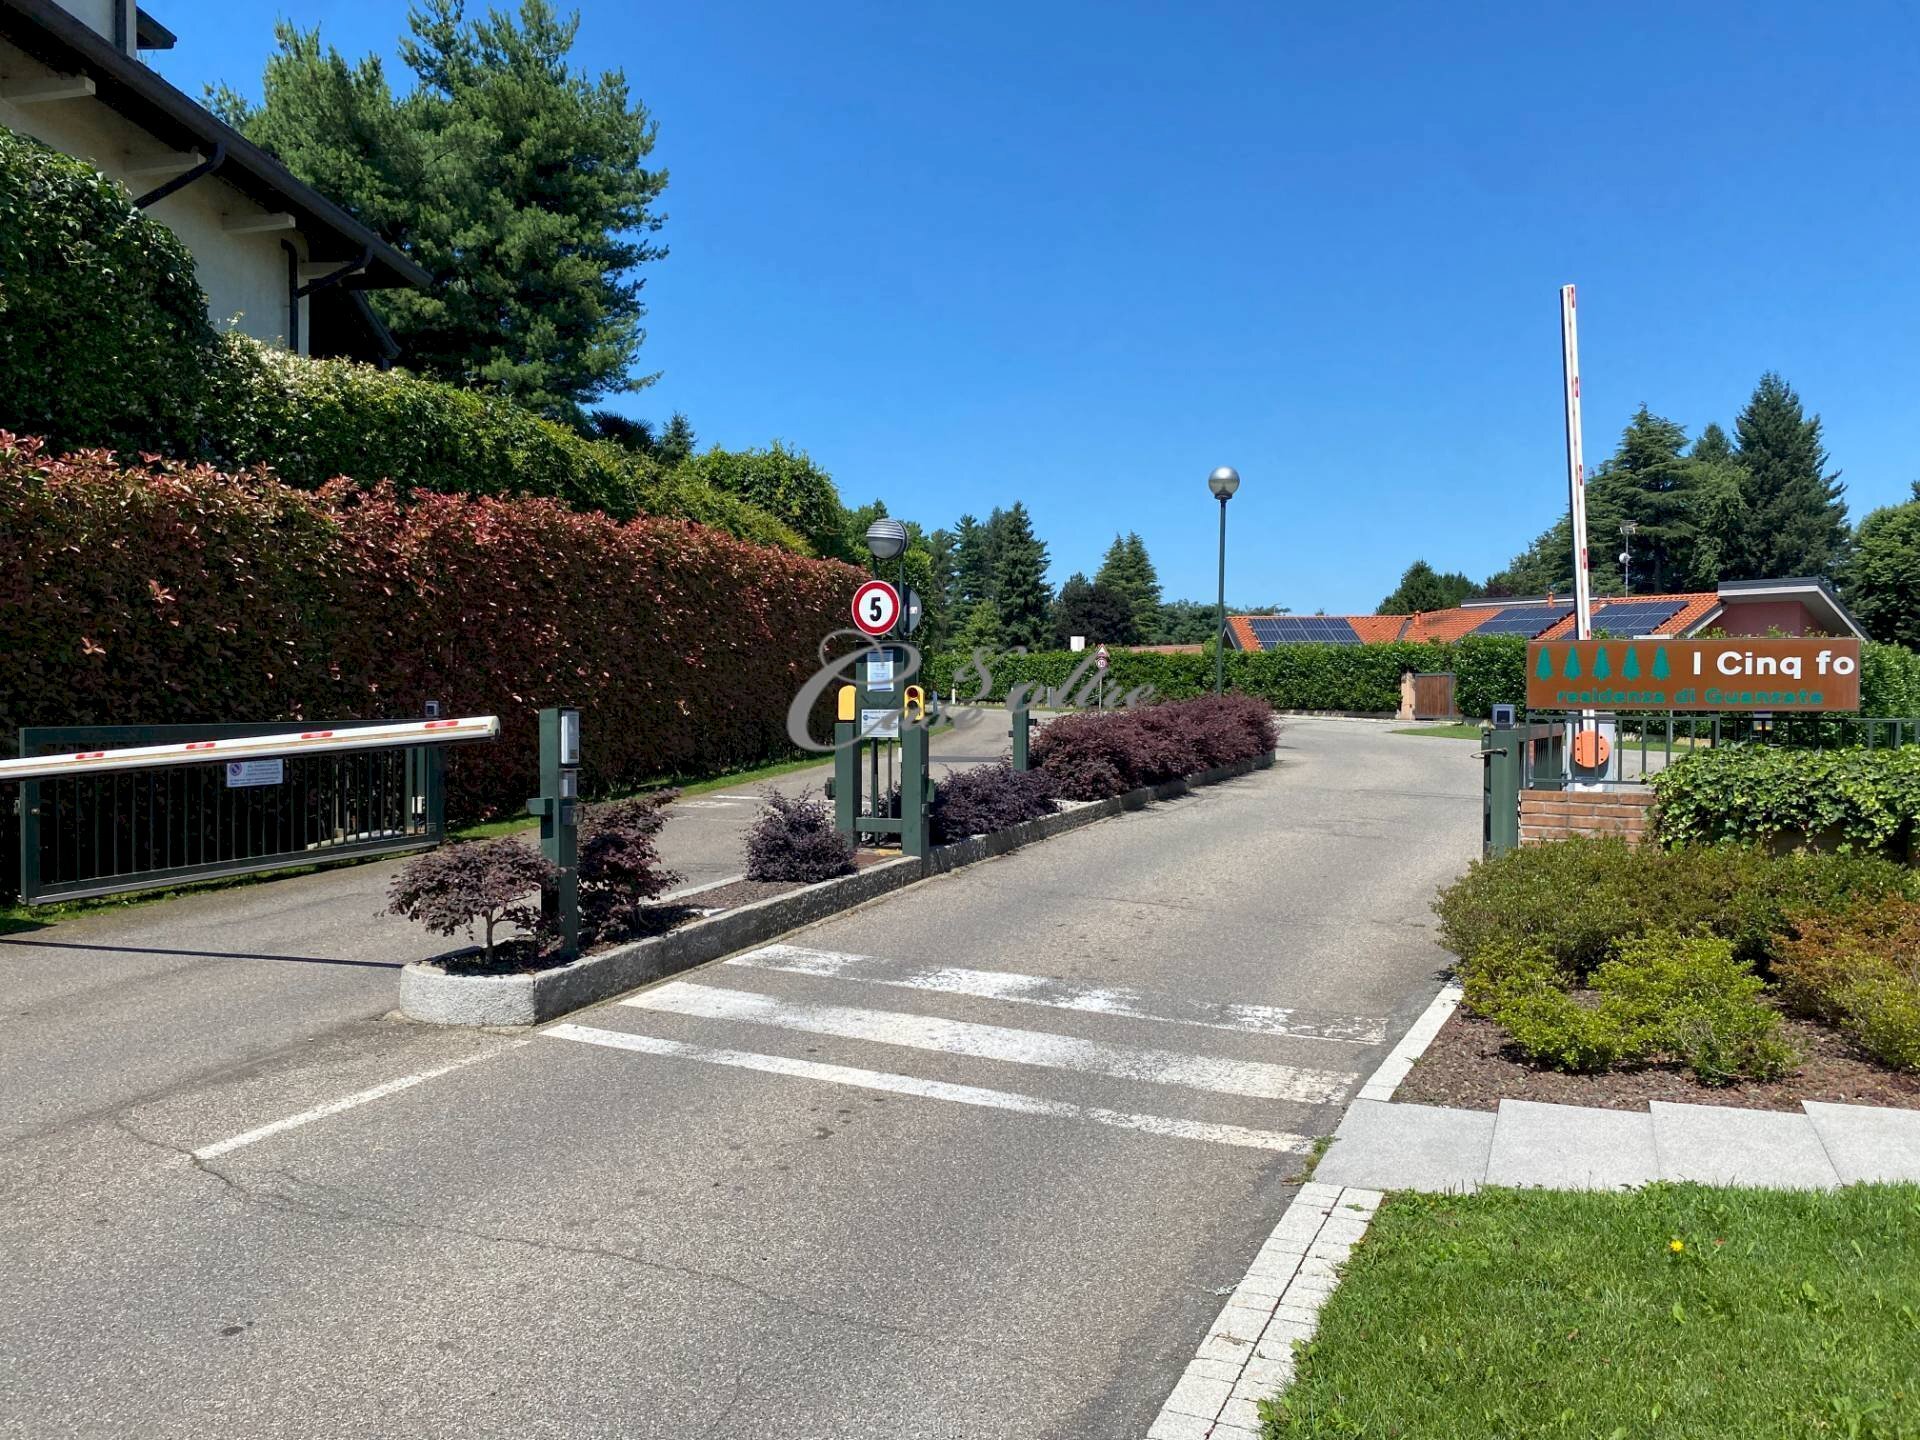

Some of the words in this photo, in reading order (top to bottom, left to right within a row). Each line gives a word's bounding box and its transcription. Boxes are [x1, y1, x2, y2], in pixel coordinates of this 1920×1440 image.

[869, 596, 882, 622] 5
[1693, 651, 1701, 676] I
[1716, 650, 1802, 680] Cinq
[1815, 650, 1855, 676] fo
[1556, 687, 1665, 705] residenza
[1674, 687, 1696, 705] di
[1704, 687, 1824, 705] Guanzate
